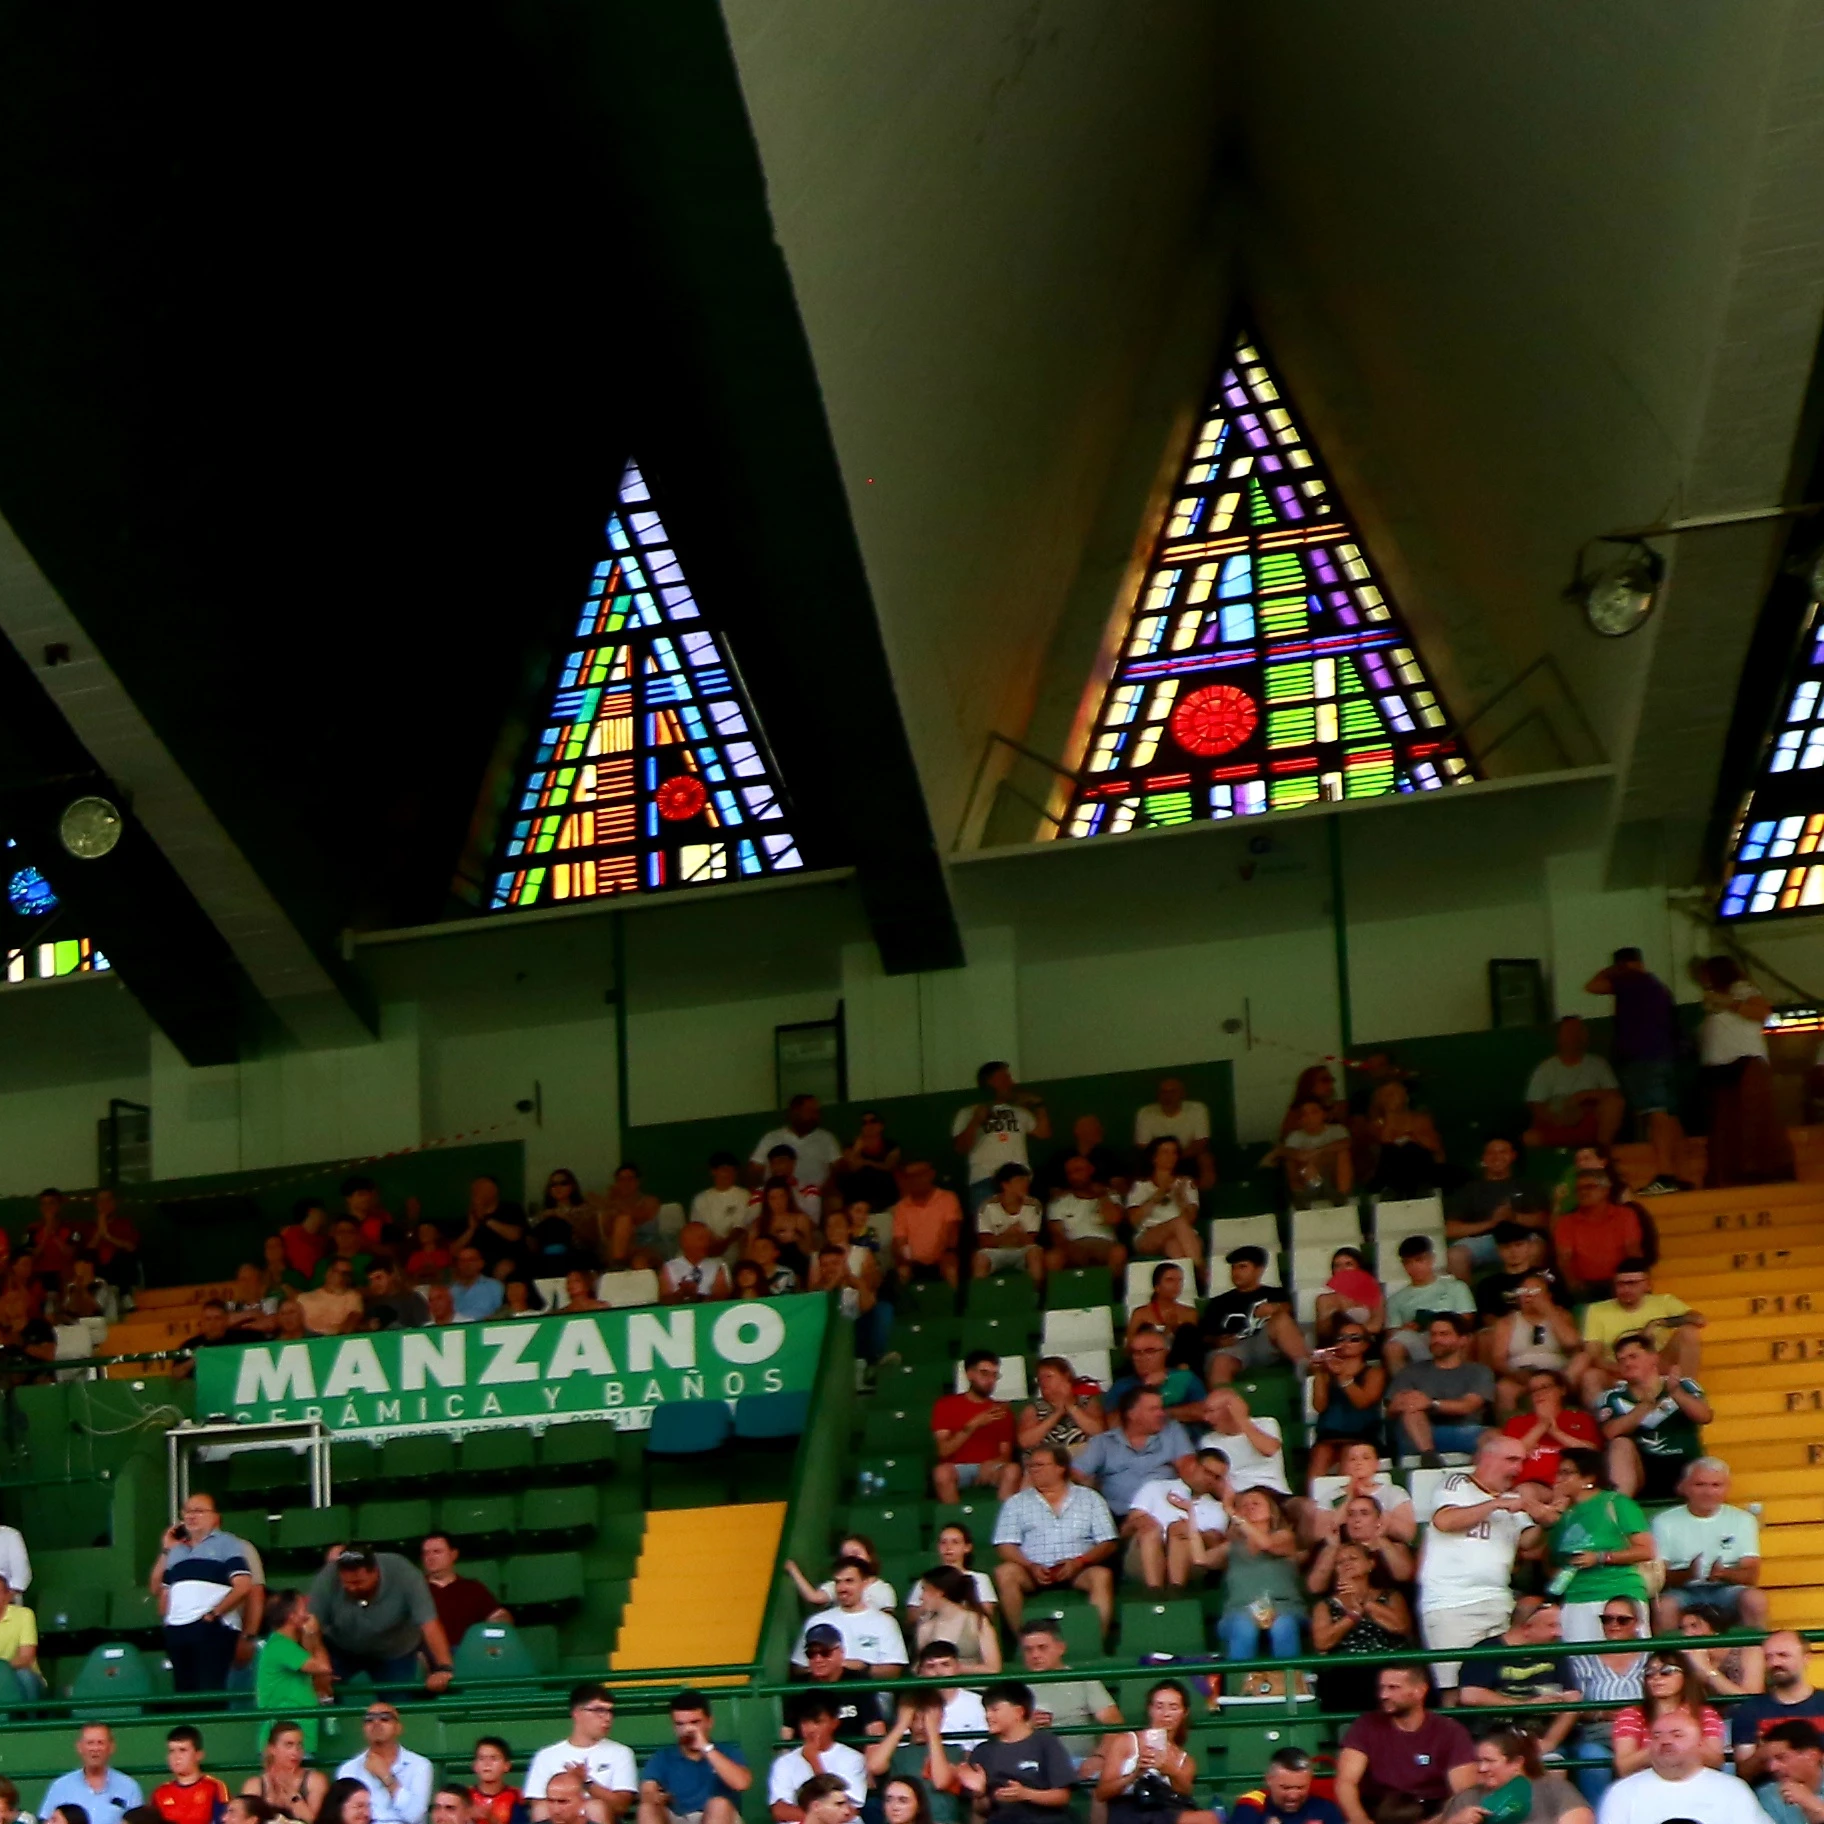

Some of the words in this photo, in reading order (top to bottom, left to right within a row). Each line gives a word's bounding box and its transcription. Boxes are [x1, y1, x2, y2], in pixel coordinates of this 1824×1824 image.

[1752, 1295, 1813, 1315] F16
[236, 1303, 785, 1405] MANZANO
[543, 1386, 561, 1410] Y
[604, 1368, 784, 1406] BAÑOS
